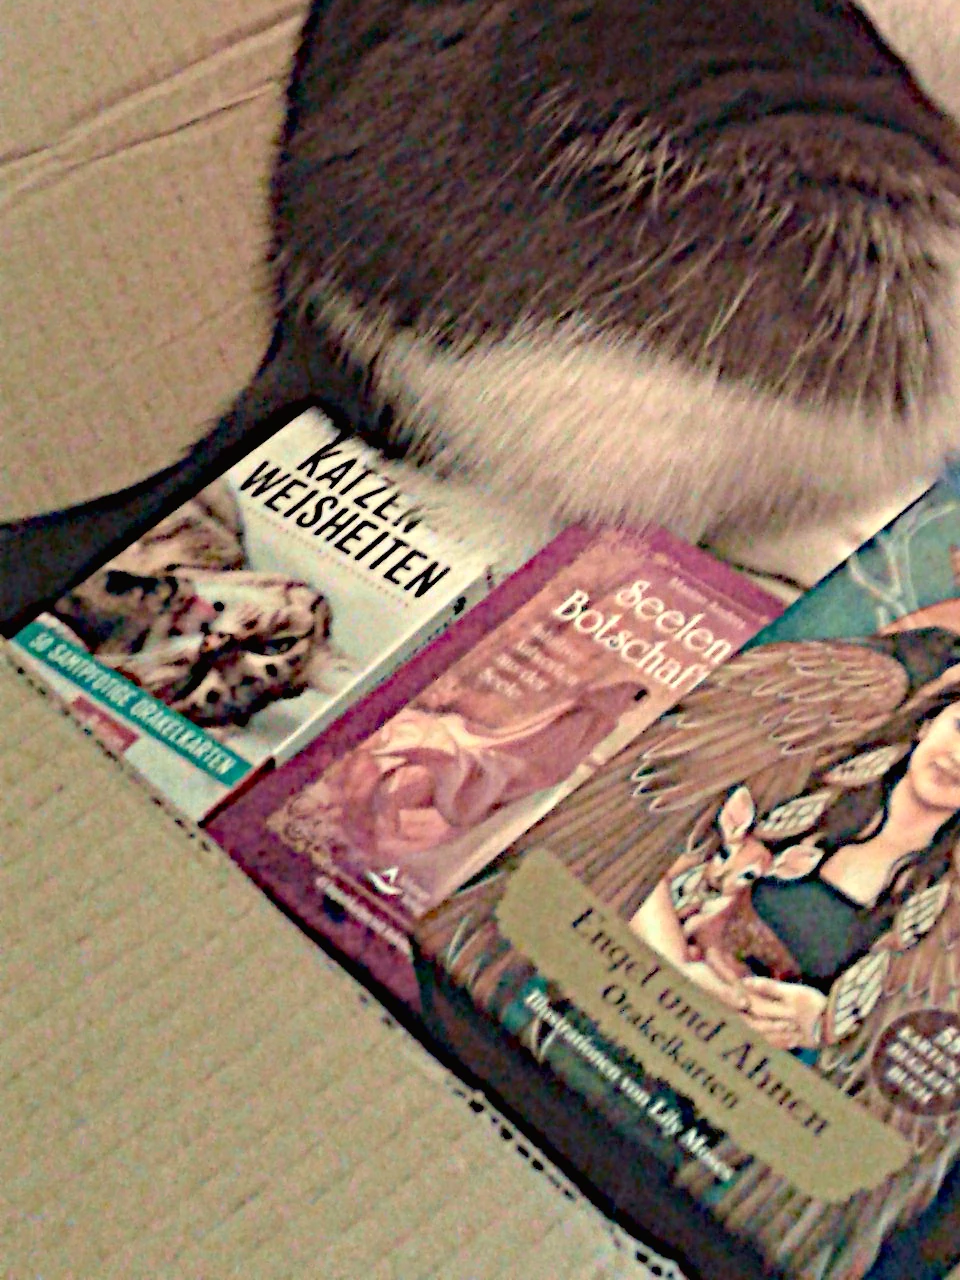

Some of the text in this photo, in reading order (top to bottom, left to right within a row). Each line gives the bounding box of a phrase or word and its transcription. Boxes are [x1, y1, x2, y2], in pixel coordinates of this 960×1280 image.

[239, 459, 452, 599] WEISHEITEN
[296, 434, 422, 534] KATZEN
[615, 579, 732, 665] Seelen
[129, 697, 238, 775] ORAKELKARTEN
[524, 988, 622, 1083] Illustrationen
[620, 1075, 651, 1108] von
[648, 1097, 684, 1137] Lily
[571, 907, 829, 1135] Engel und Ahnen
[601, 983, 739, 1109] Orakelkarten
